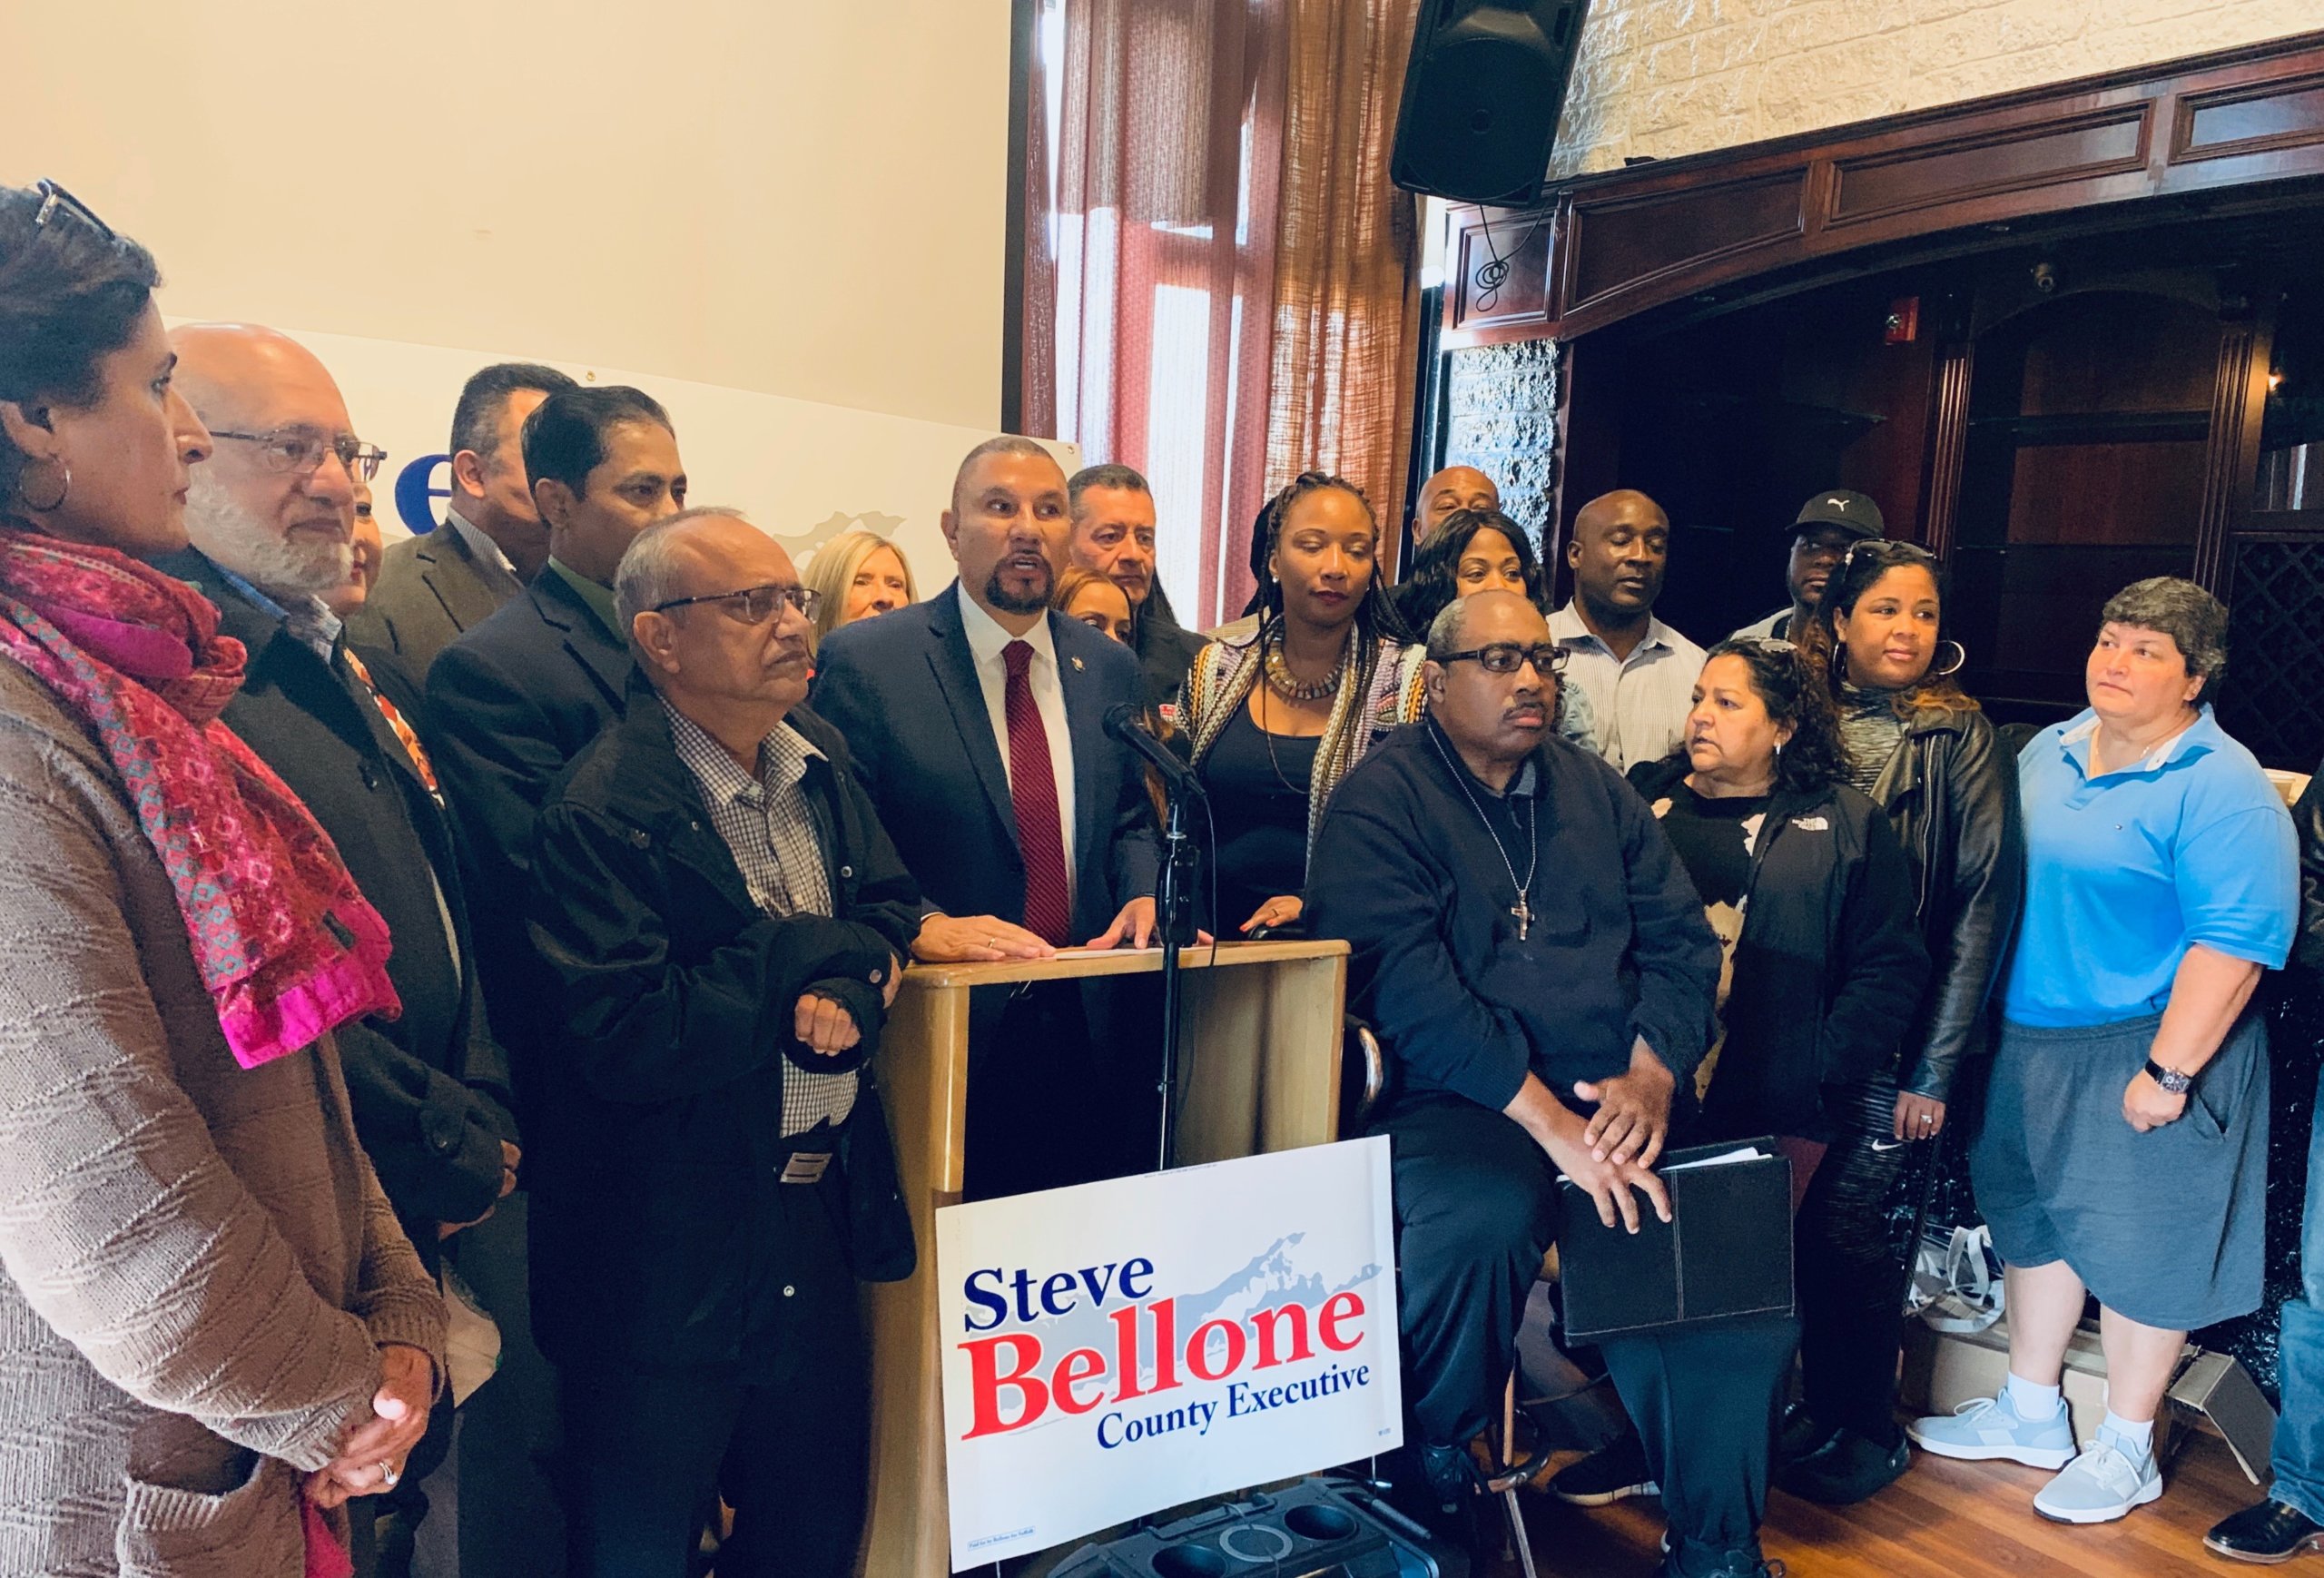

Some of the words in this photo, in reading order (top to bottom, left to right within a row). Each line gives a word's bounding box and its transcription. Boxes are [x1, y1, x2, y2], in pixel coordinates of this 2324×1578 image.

[964, 1257, 1154, 1333] Steve
[957, 1292, 1365, 1441] Bellone
[1097, 1401, 1217, 1449] County
[1227, 1364, 1370, 1418] Executive
